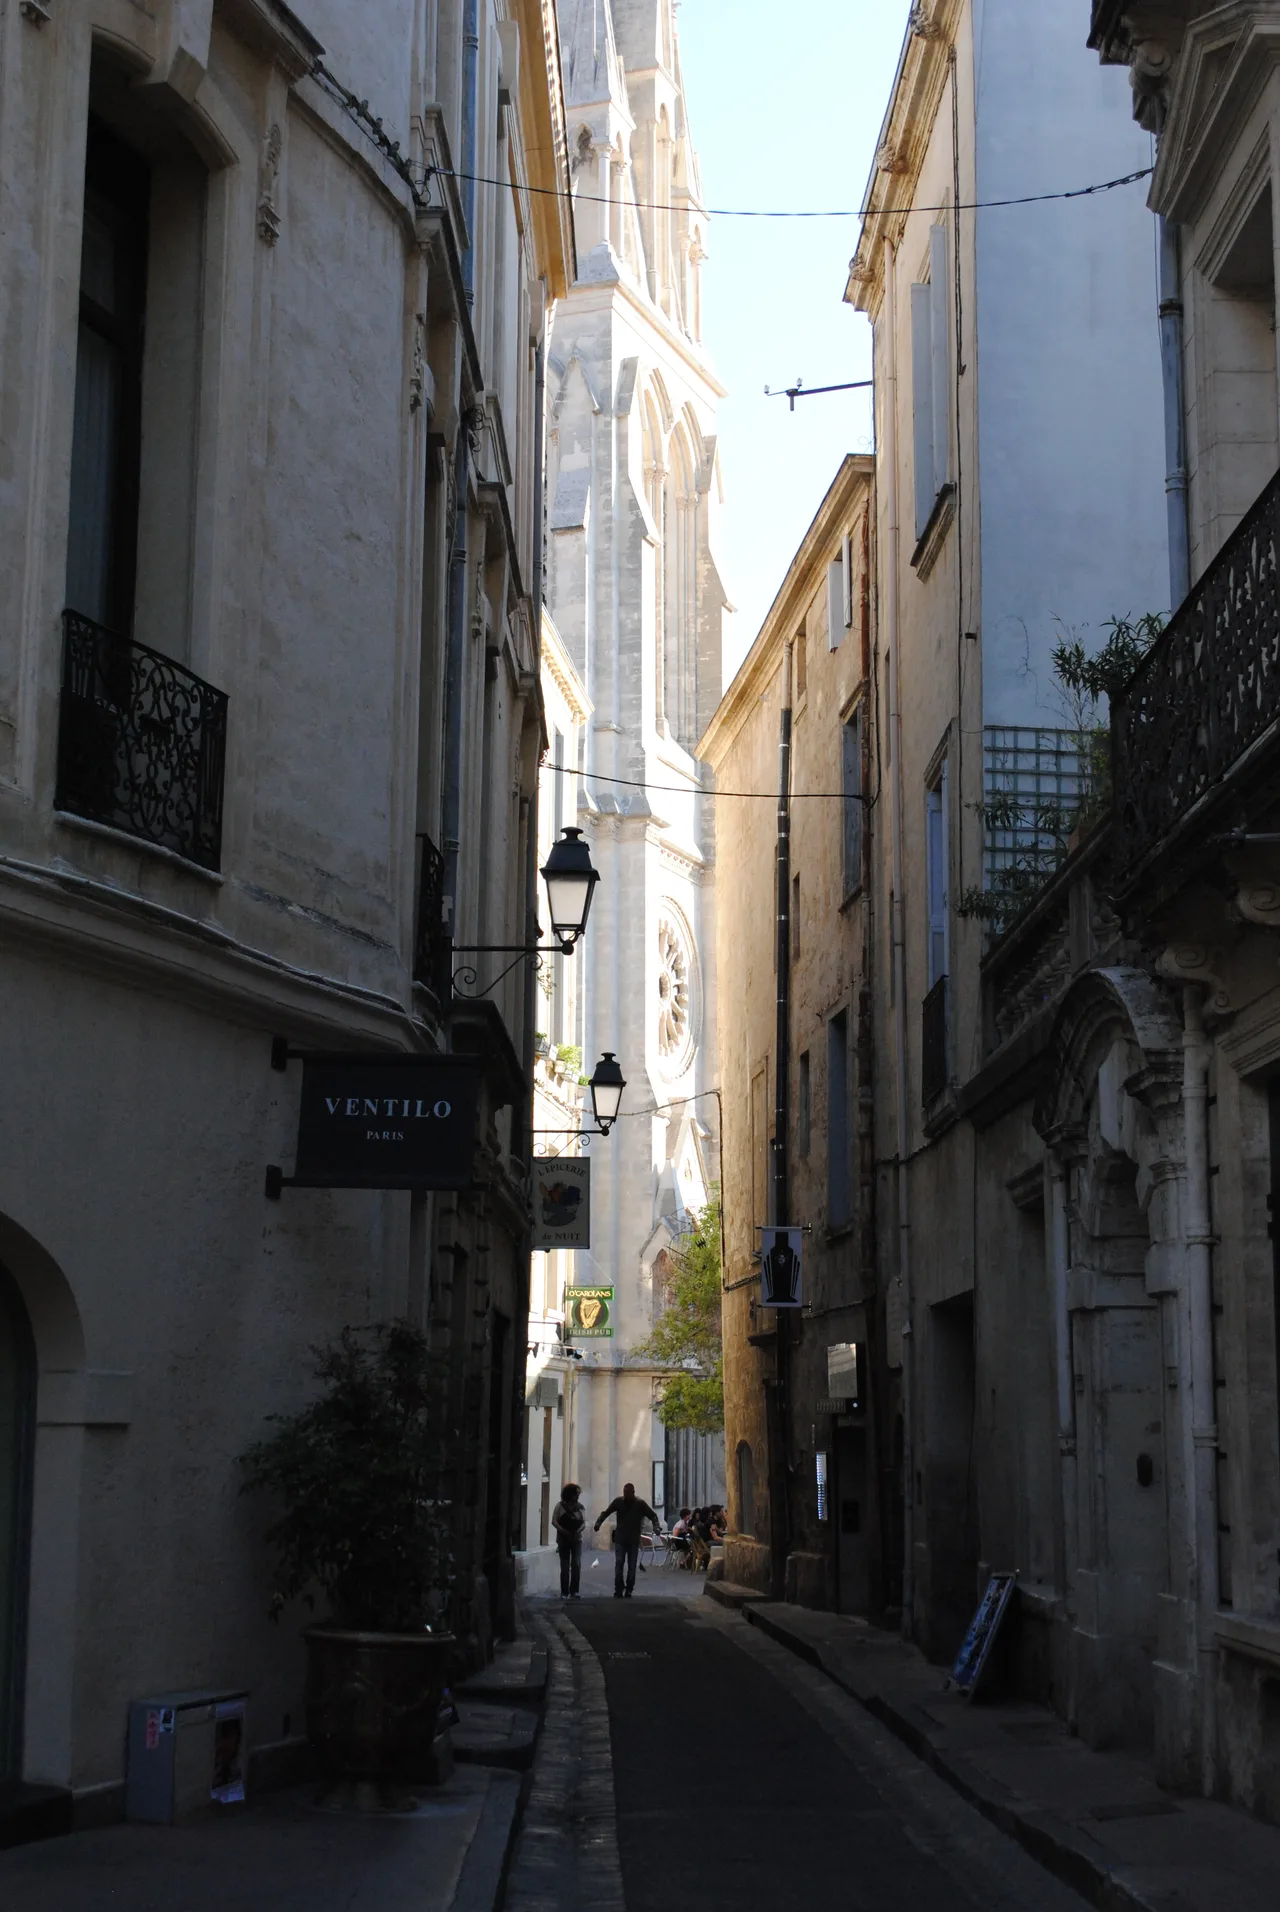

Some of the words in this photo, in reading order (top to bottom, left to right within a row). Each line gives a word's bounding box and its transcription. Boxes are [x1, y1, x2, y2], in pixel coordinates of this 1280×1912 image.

[324, 1097, 452, 1119] VENTILO
[366, 1130, 405, 1141] PARIS
[555, 1232, 581, 1241] NUIT
